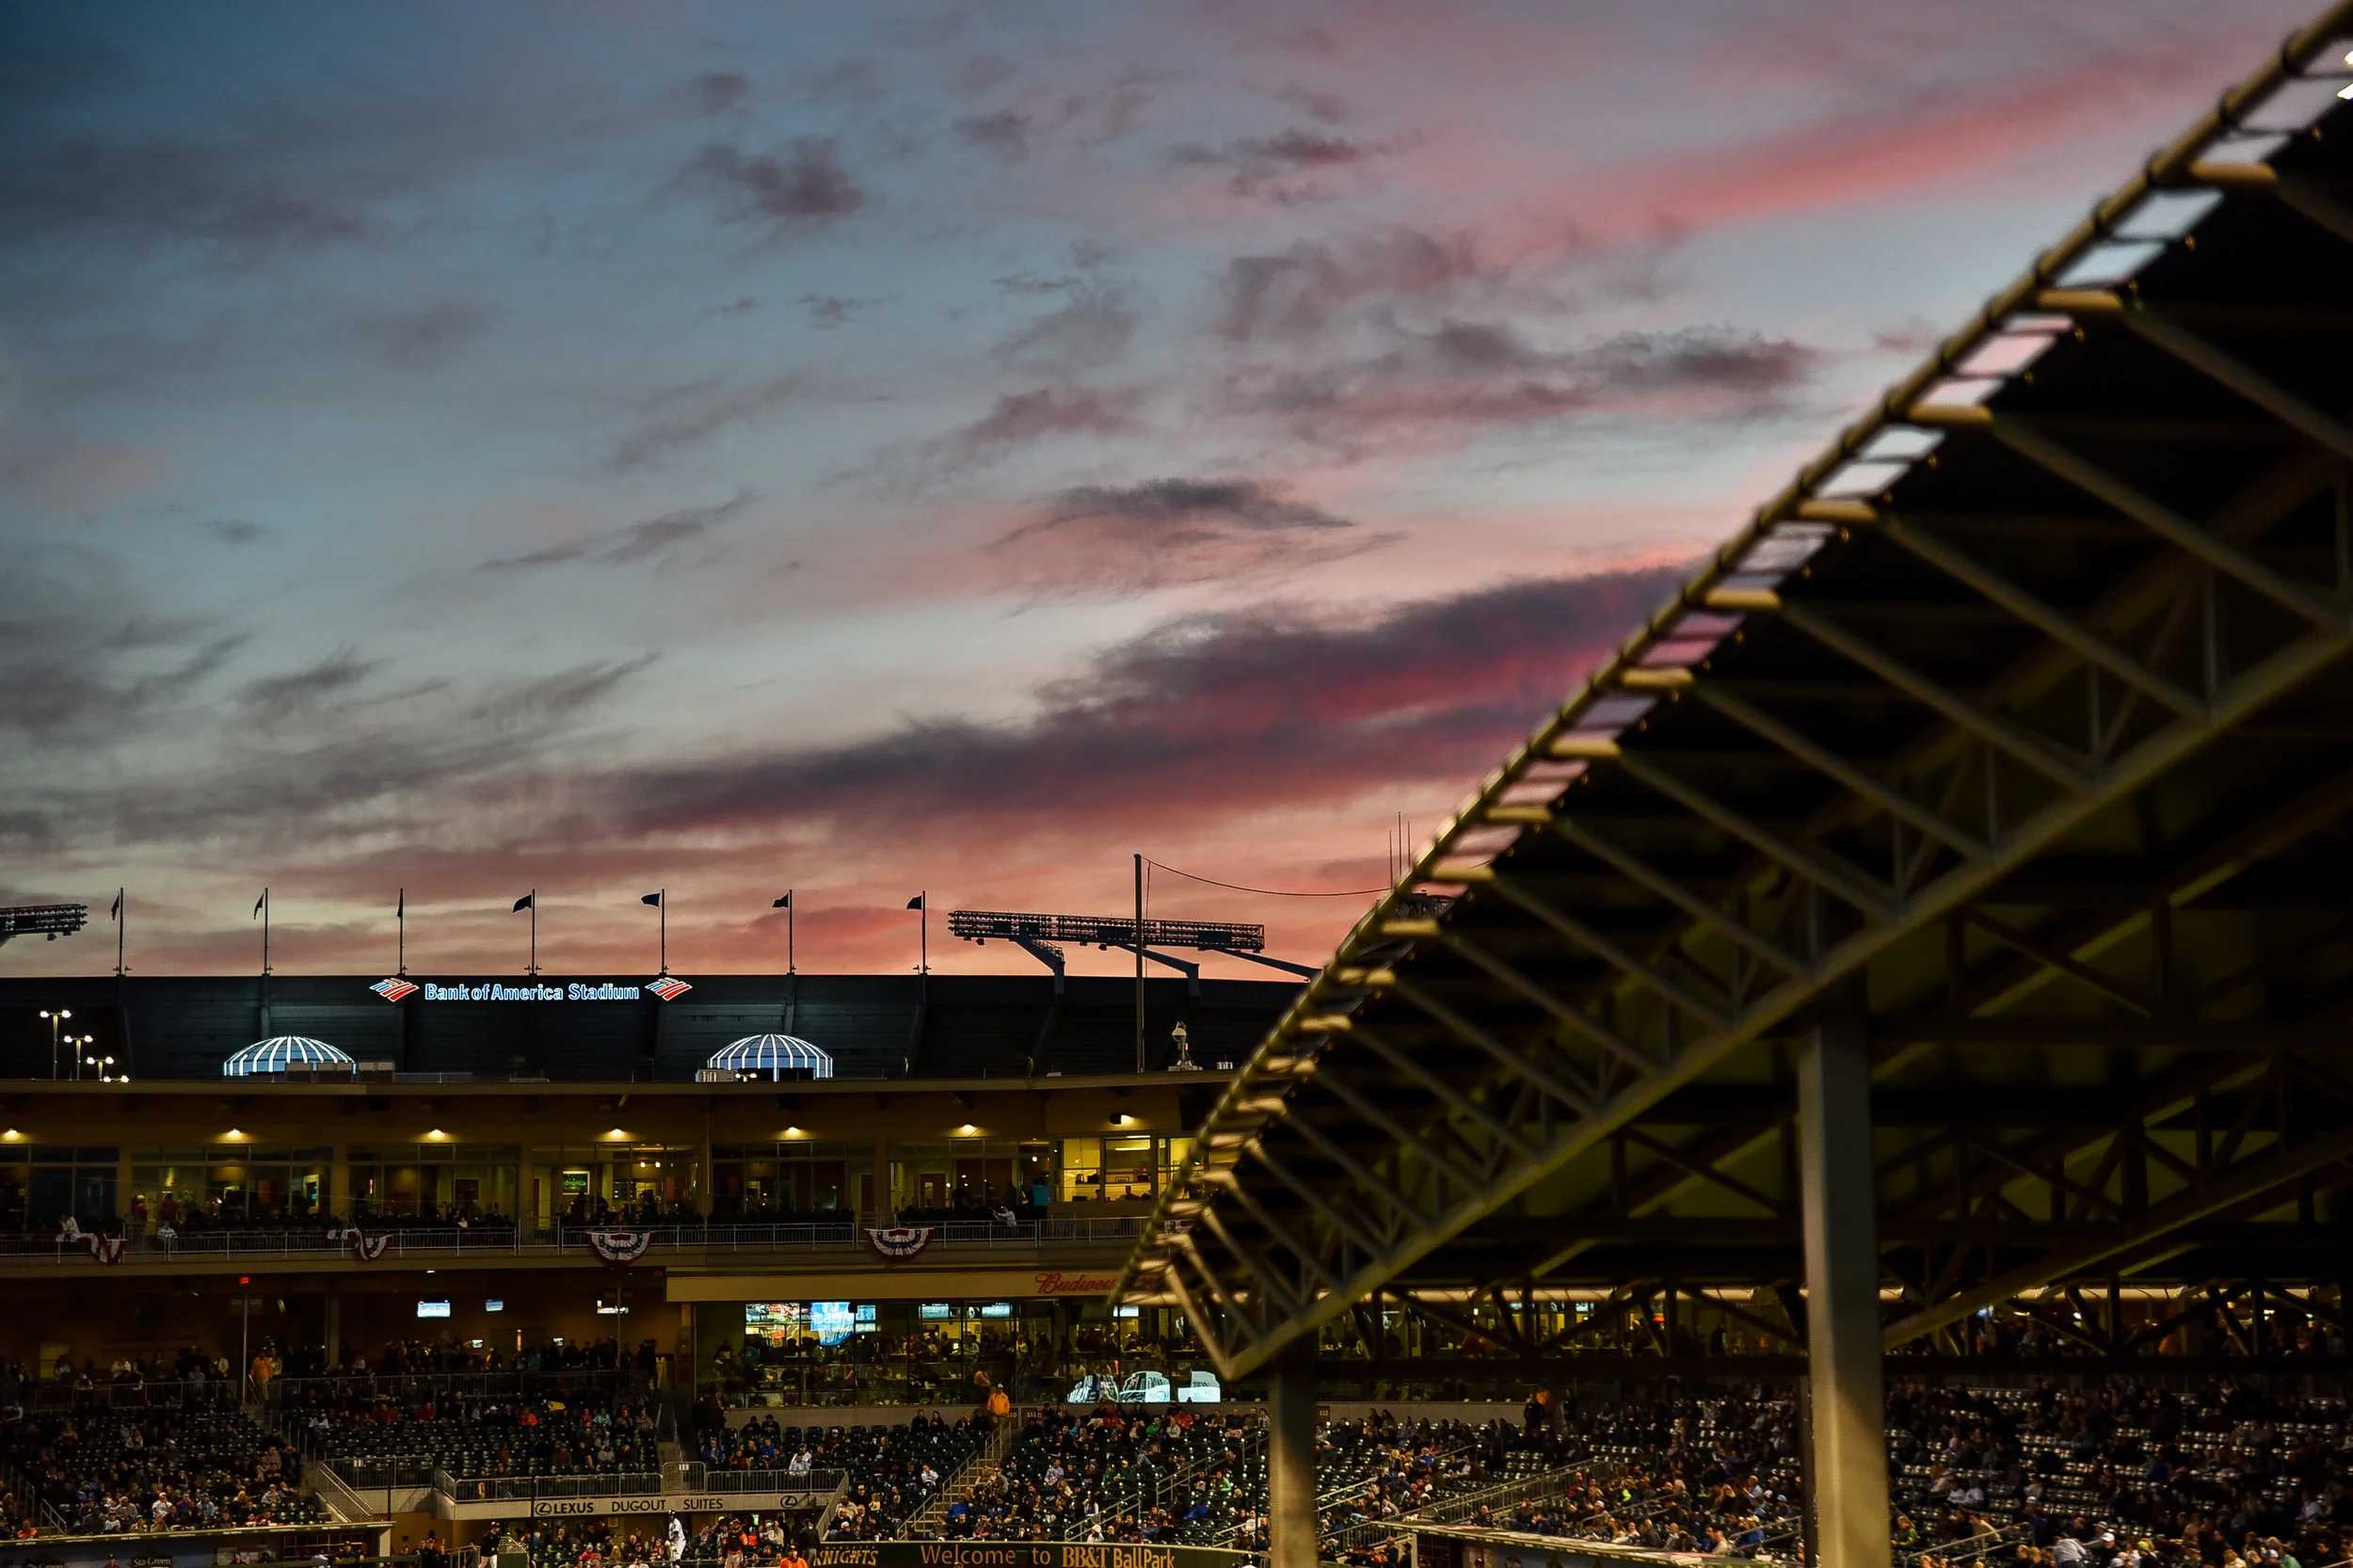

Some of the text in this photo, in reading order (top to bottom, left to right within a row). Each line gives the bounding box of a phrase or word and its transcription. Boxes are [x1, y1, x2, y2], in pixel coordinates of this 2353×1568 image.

[424, 983, 640, 1000] Bank of America Stadium
[553, 1497, 723, 1514] LEXUS DUGOUT SUITES
[920, 1544, 1176, 1568] Welcome to BB&T BallPark
